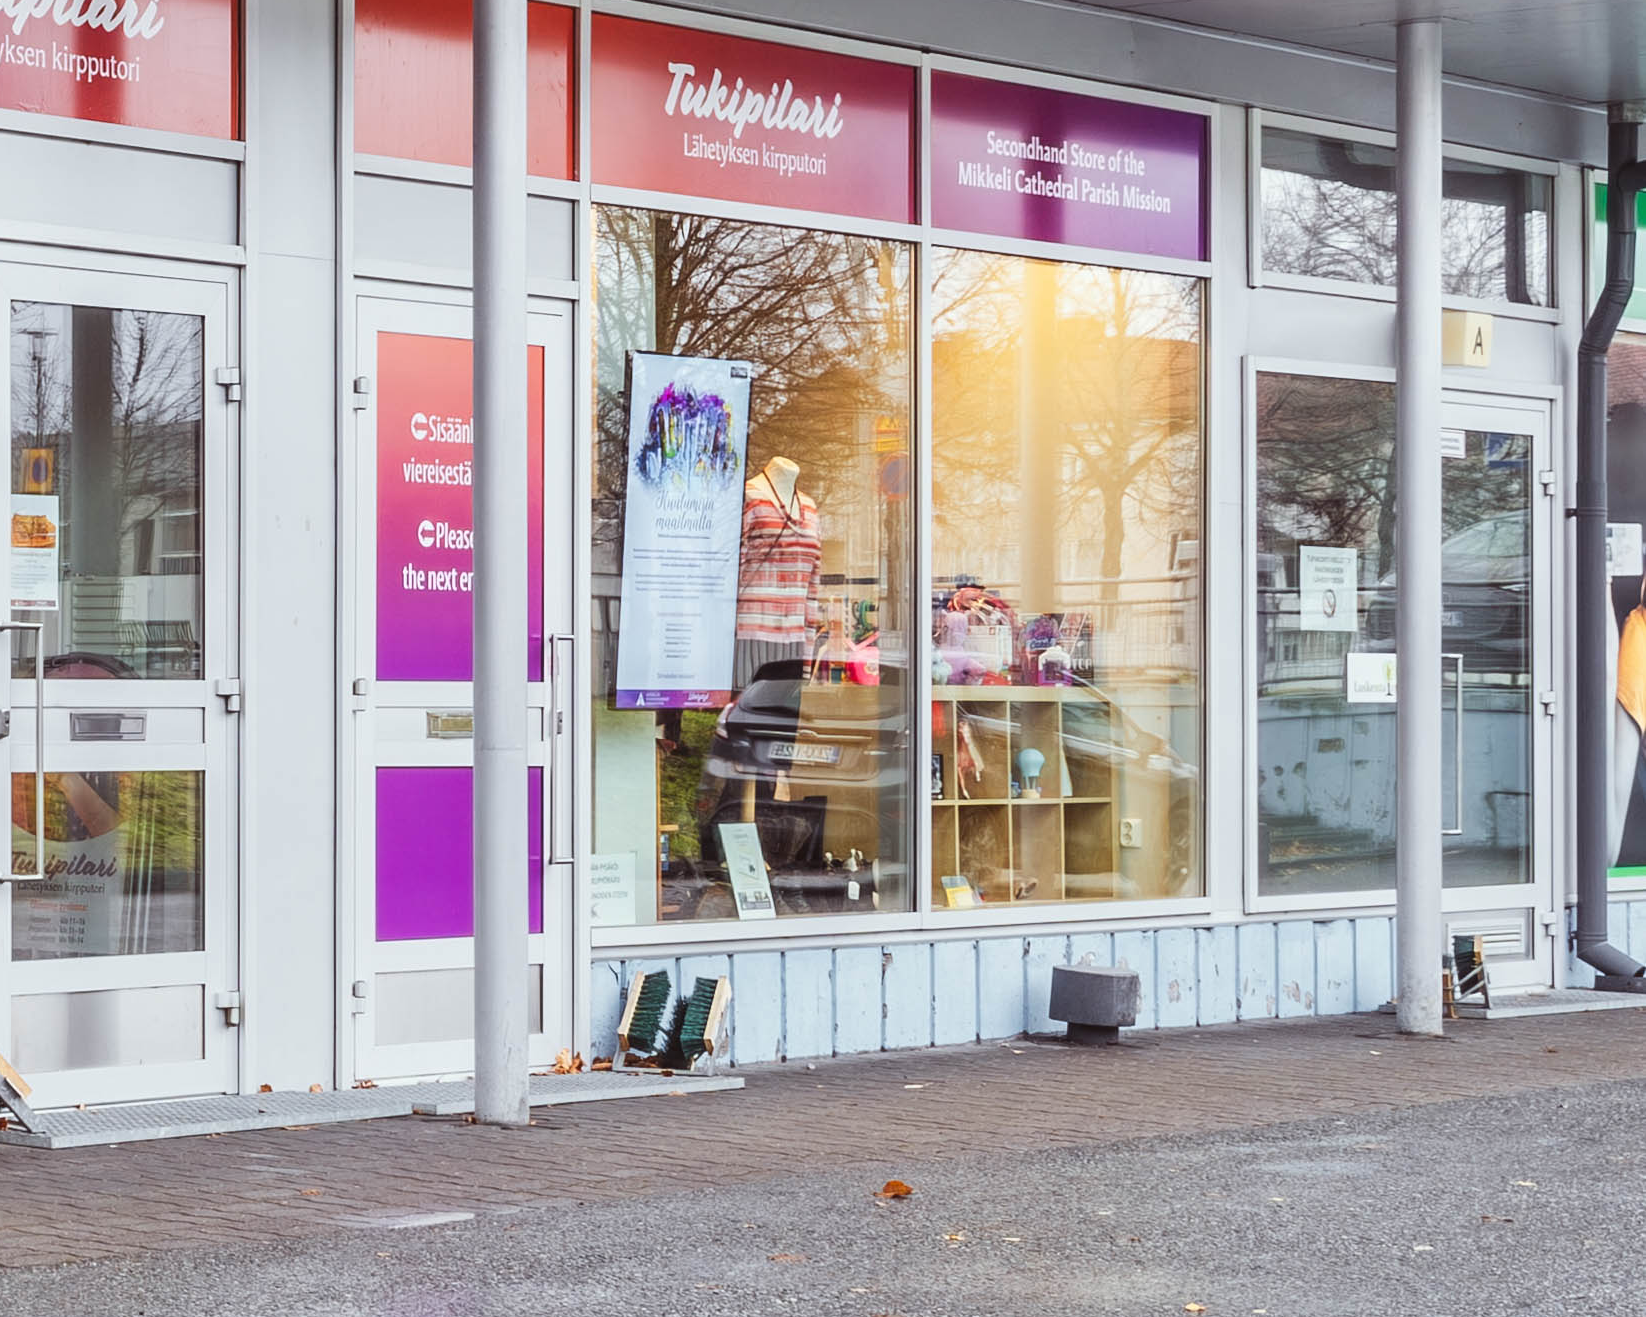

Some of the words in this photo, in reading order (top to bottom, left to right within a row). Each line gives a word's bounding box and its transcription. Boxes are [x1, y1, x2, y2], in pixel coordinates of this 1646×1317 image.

[53, 43, 140, 81] kirpputori
[665, 63, 843, 139] Tukipilari
[684, 134, 758, 167] Lähetyksen
[763, 144, 826, 176] kirpputori
[985, 131, 1068, 167] Secondhand
[1070, 144, 1104, 171] Store
[1108, 148, 1125, 172] of
[1125, 152, 1144, 177] the
[959, 162, 1011, 190] Mikkeli
[1014, 167, 1079, 202] Cathedral
[1082, 178, 1119, 206] Parish
[1123, 186, 1172, 213] Mission
[1473, 327, 1484, 356] A
[403, 457, 472, 485] viereisestä
[403, 563, 425, 590] the
[428, 569, 457, 591] next
[11, 851, 117, 881] Tuipilari
